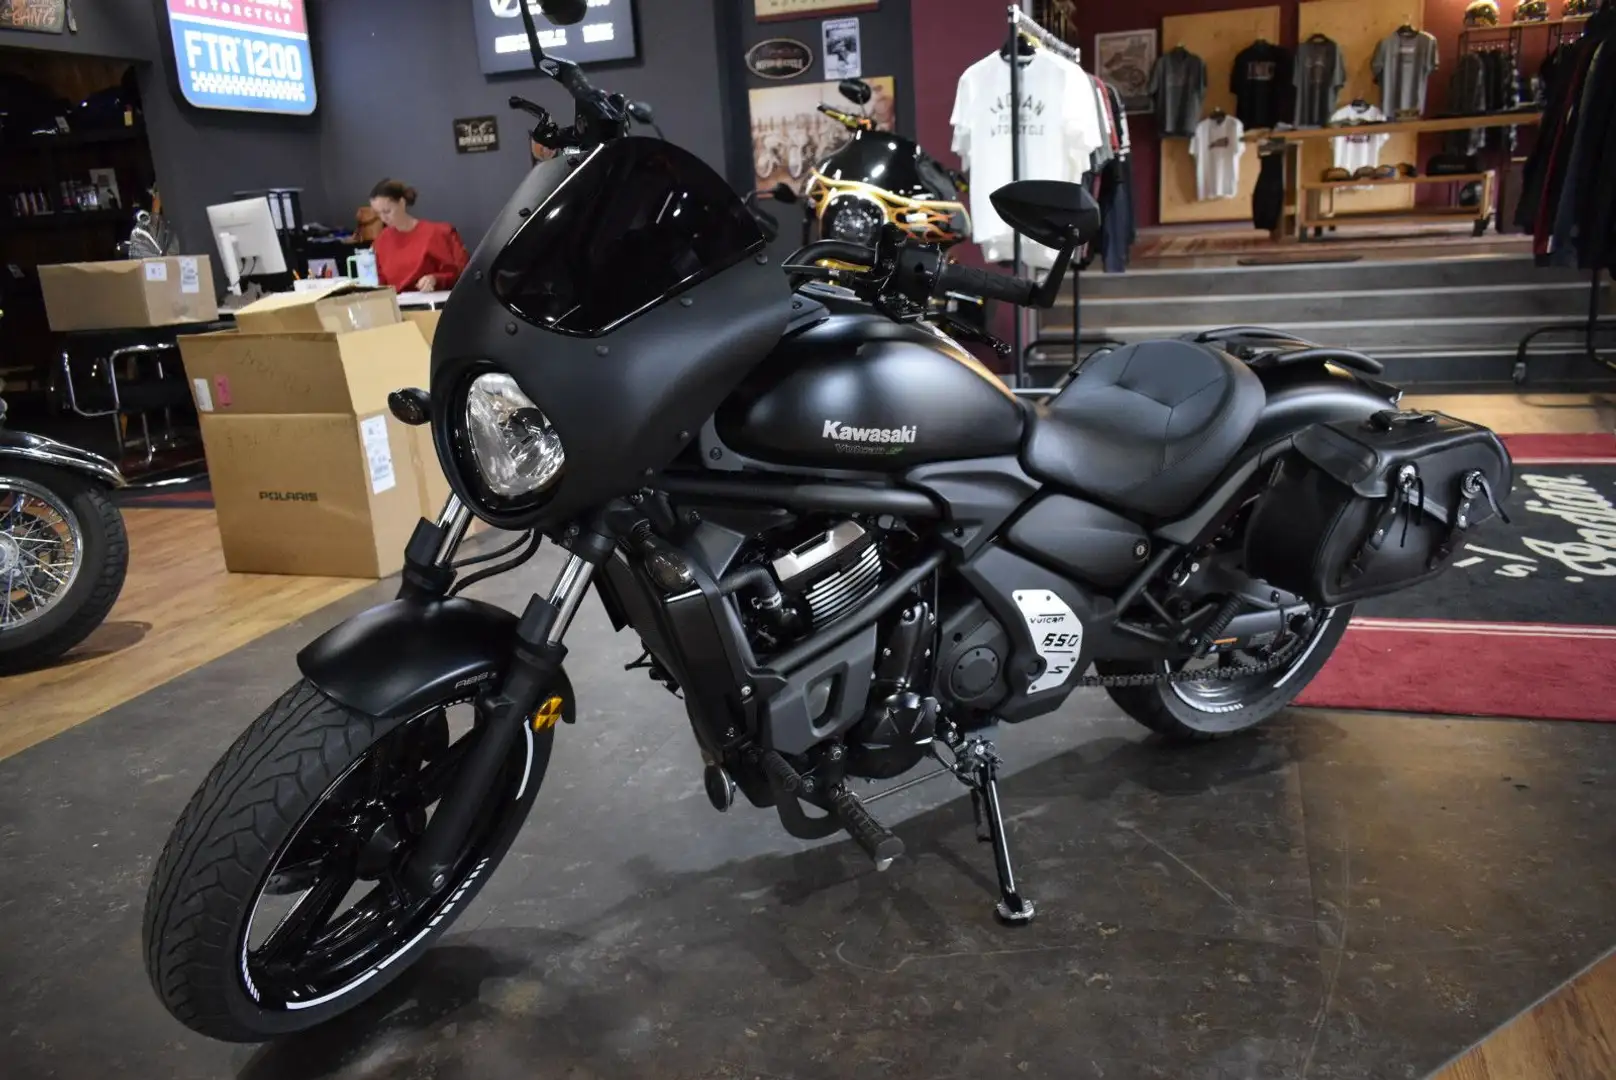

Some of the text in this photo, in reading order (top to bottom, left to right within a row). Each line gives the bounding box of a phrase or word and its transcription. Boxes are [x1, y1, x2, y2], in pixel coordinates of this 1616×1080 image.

[184, 29, 304, 81] FTR 1200
[822, 419, 918, 443] Kawasaki
[258, 490, 319, 502] POLARIS
[1042, 632, 1079, 648] 650
